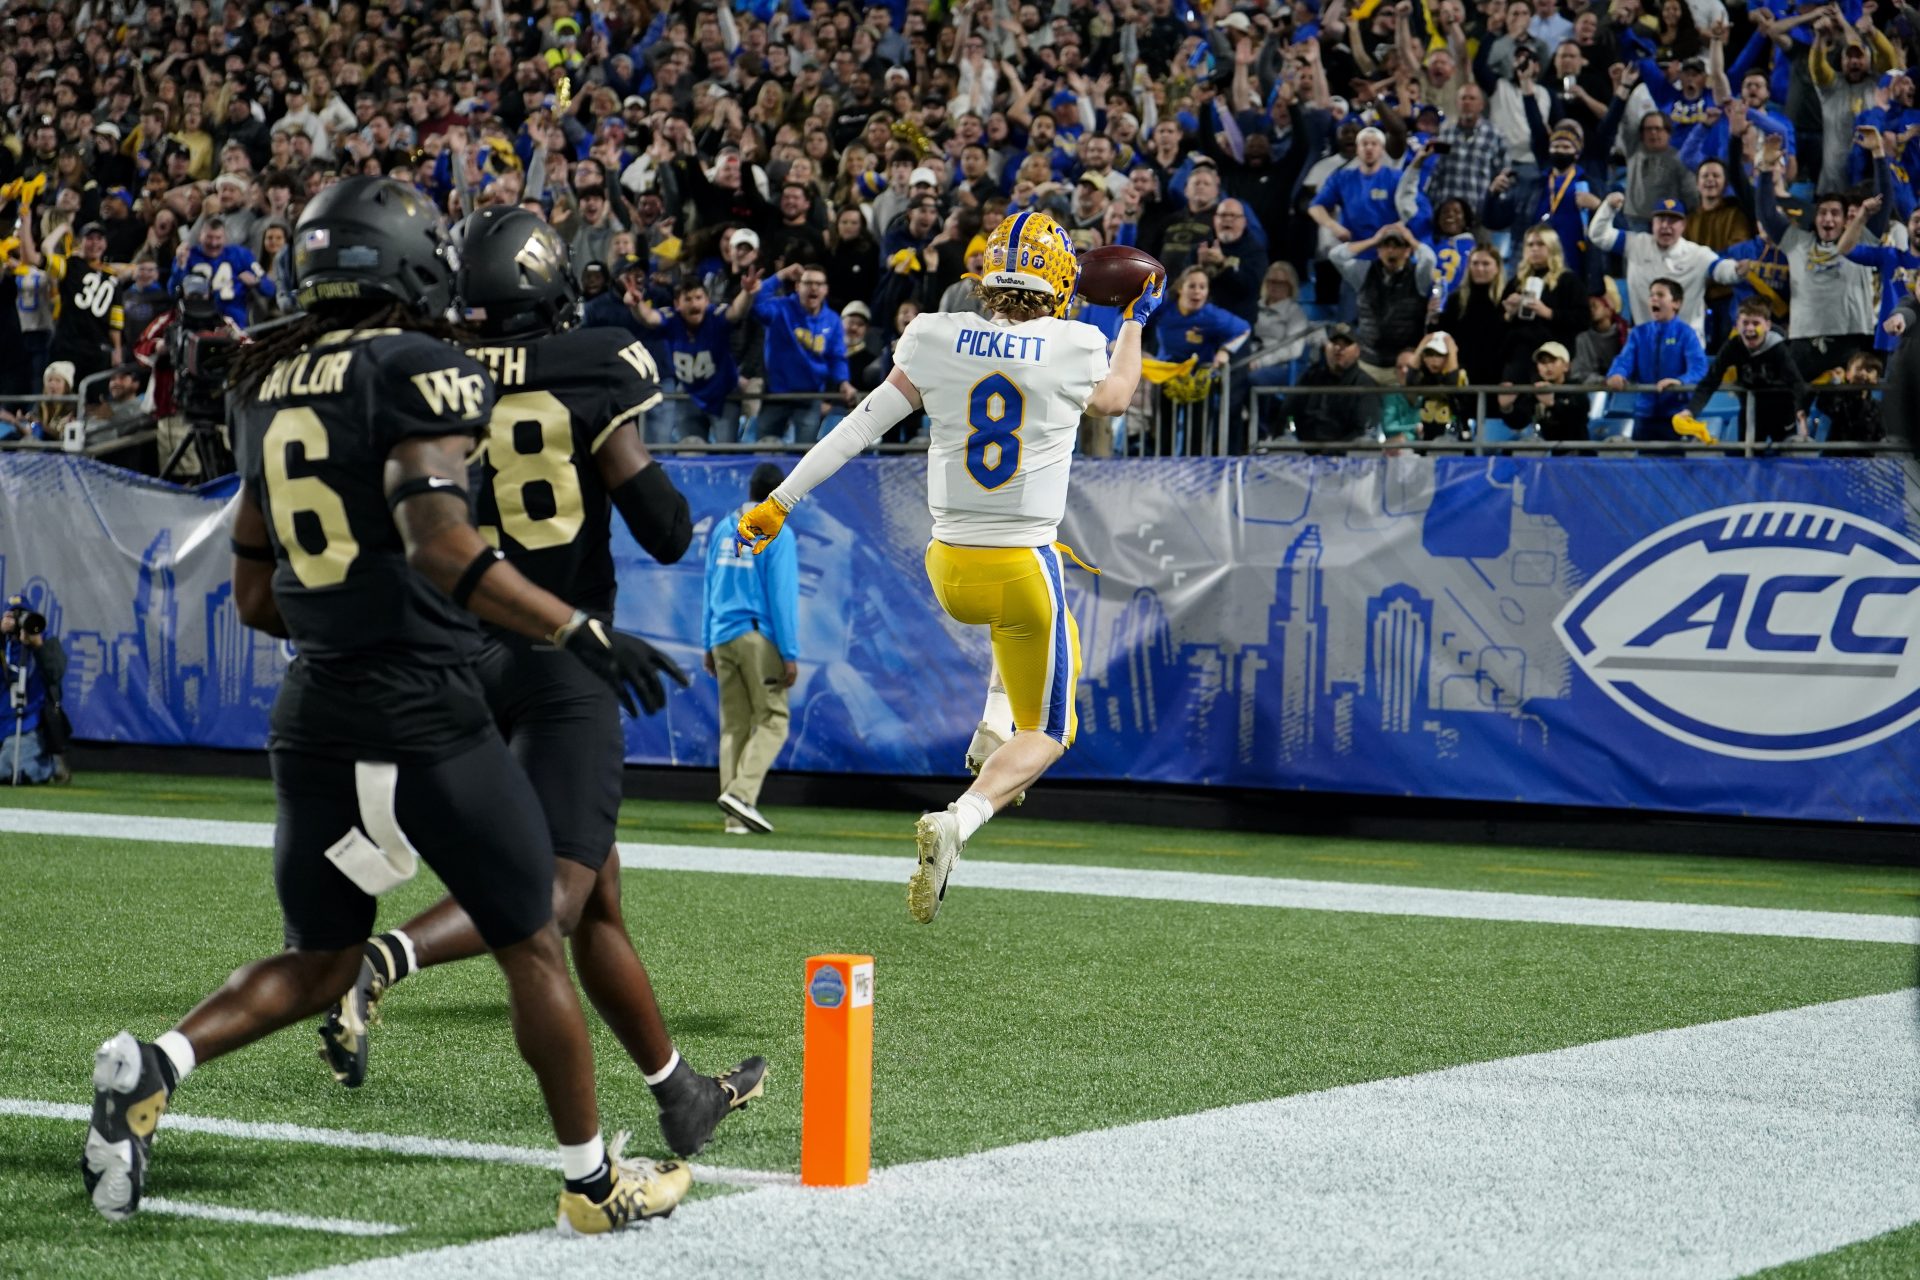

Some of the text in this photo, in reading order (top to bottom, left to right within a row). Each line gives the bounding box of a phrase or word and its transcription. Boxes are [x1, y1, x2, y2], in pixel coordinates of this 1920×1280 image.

[995, 275, 1025, 286] Panthers
[1021, 250, 1029, 267] 8
[1033, 256, 1044, 267] FF
[74, 272, 115, 318] 30
[673, 350, 716, 384] 94
[956, 329, 1046, 361] PICKETT
[410, 367, 486, 420] WF
[964, 370, 1026, 492] 8
[478, 390, 586, 550] 8
[263, 406, 360, 589] 6
[1623, 573, 1920, 655] ACC
